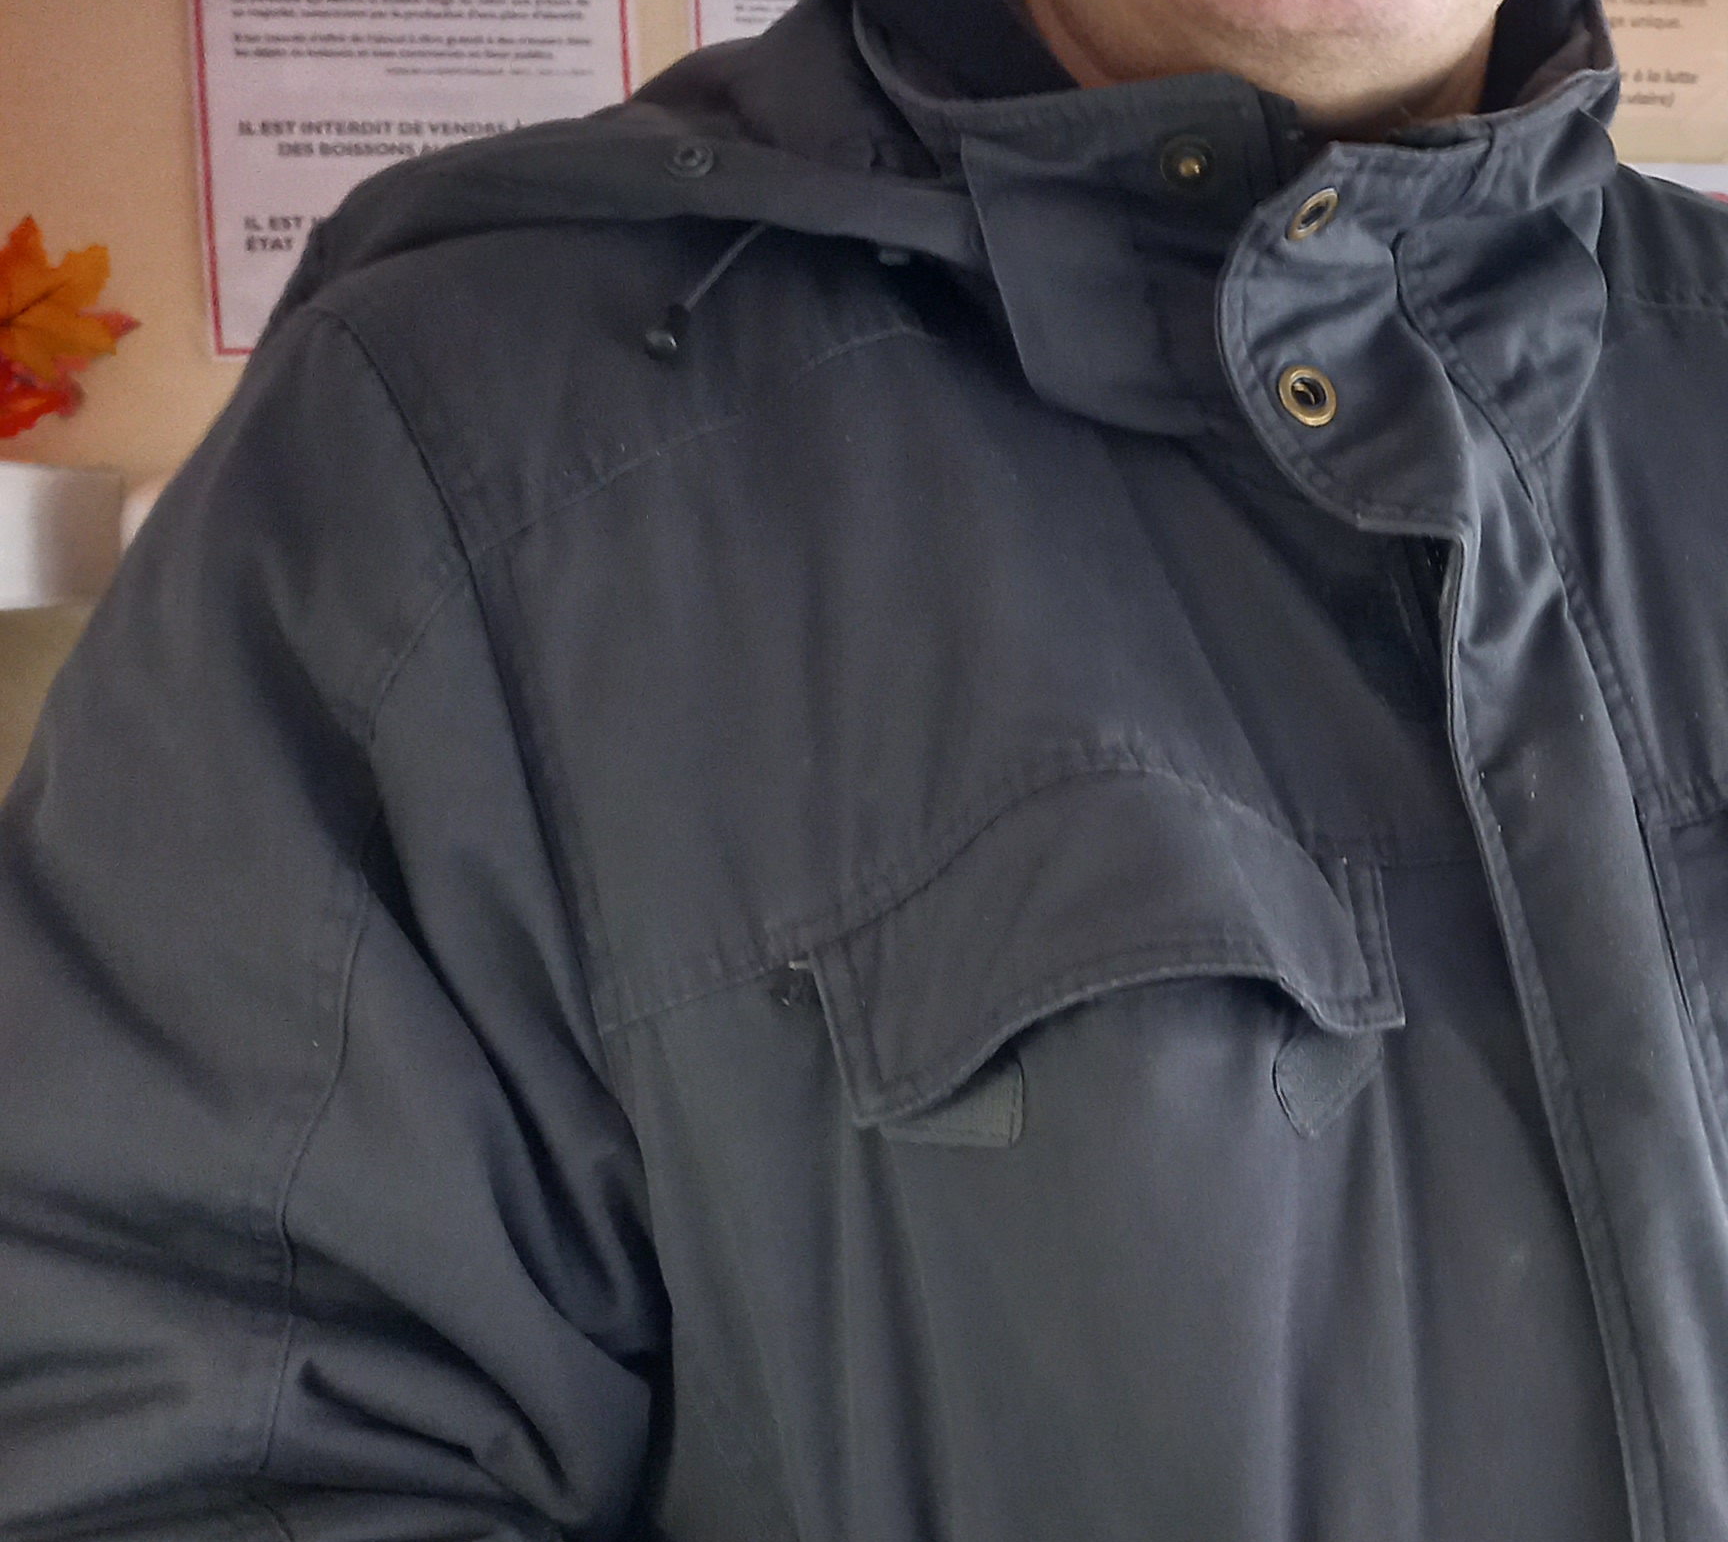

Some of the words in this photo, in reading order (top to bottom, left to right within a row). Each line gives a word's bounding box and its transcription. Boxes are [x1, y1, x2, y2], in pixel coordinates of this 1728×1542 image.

[237, 120, 256, 136] IL
[260, 120, 297, 136] EST
[301, 121, 392, 136] INTERDIT
[398, 122, 426, 136] DE
[430, 122, 507, 136] VENDRE
[277, 142, 314, 156] DES
[319, 142, 416, 157] BOISSONS
[243, 215, 262, 232] IL
[269, 215, 303, 232] EST
[245, 234, 293, 252] ÉTAT
